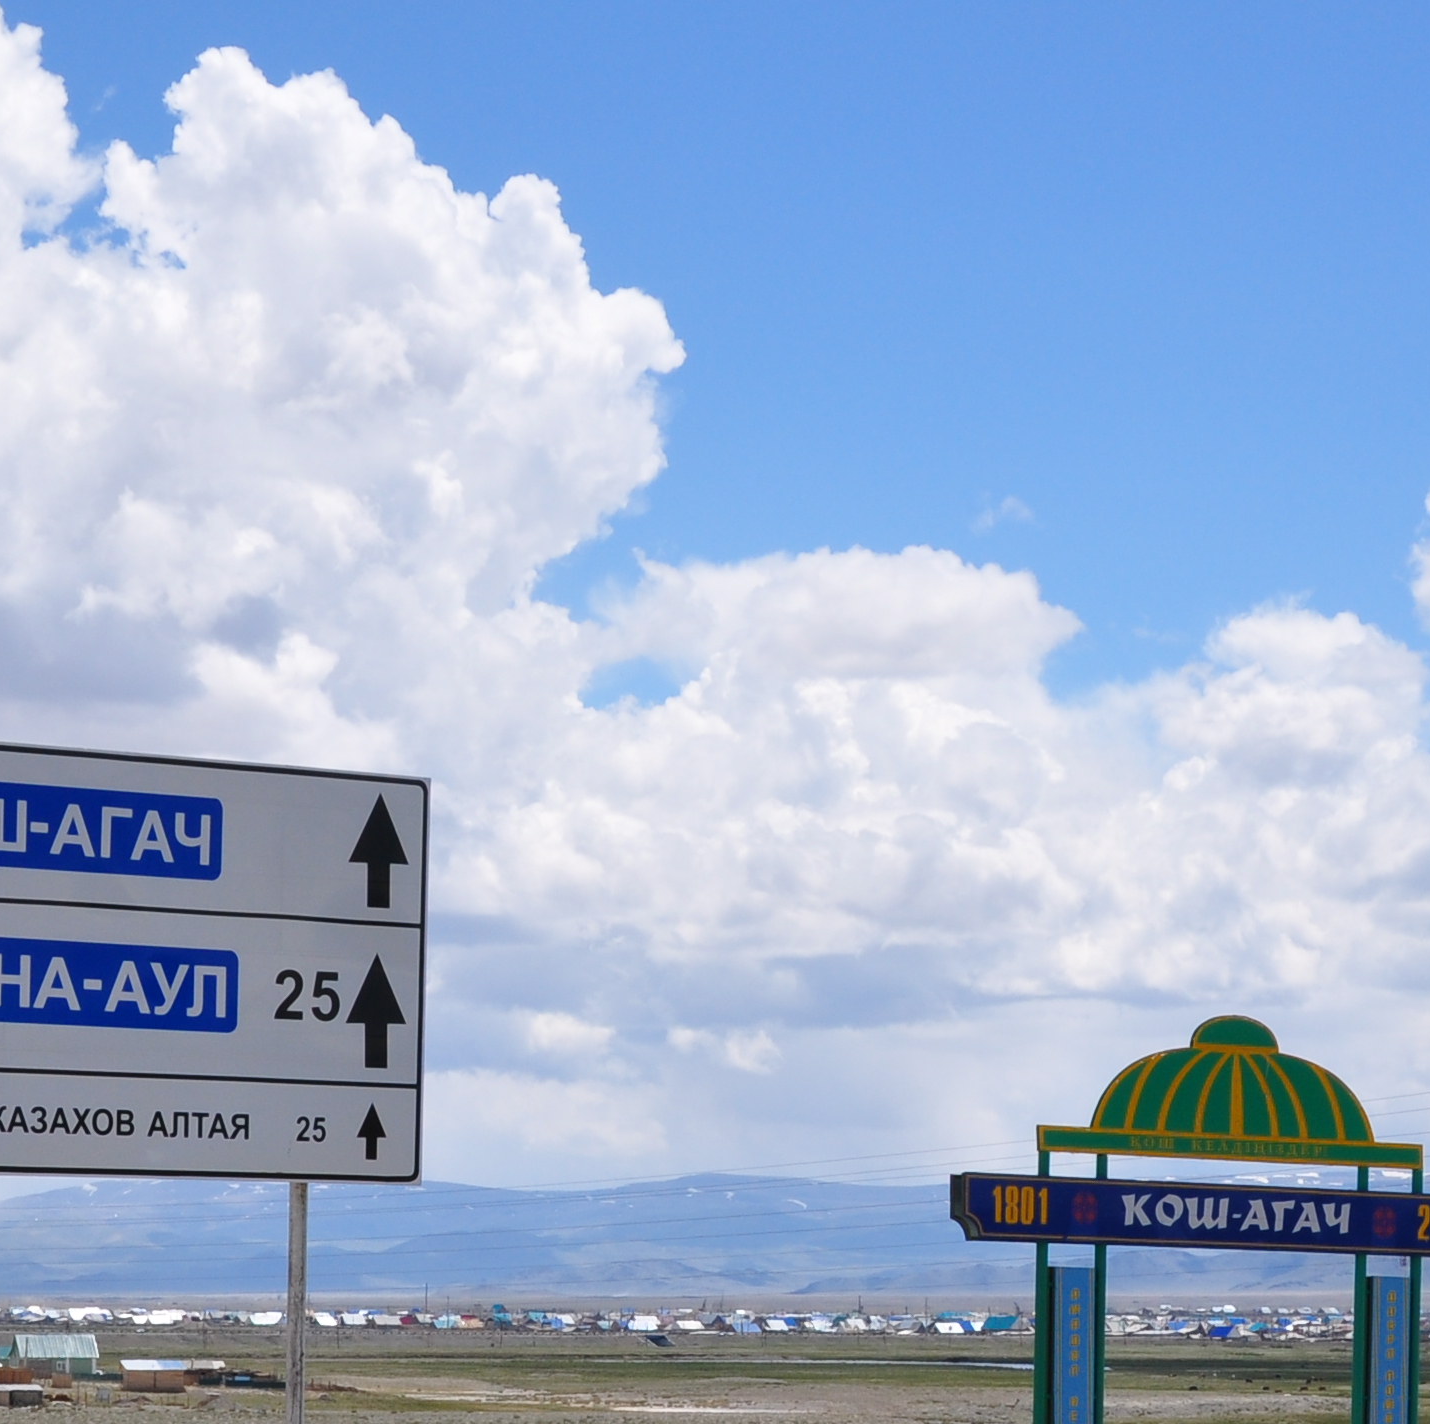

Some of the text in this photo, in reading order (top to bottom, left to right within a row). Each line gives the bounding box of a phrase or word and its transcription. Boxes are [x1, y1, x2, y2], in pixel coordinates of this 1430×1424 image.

[273, 968, 341, 1022] 25
[147, 1109, 251, 1141] АЛТАЯ
[295, 1115, 328, 1143] 25
[991, 1185, 1050, 1225] 1801
[1122, 1193, 1352, 1235] КОШ-АГАЧ
